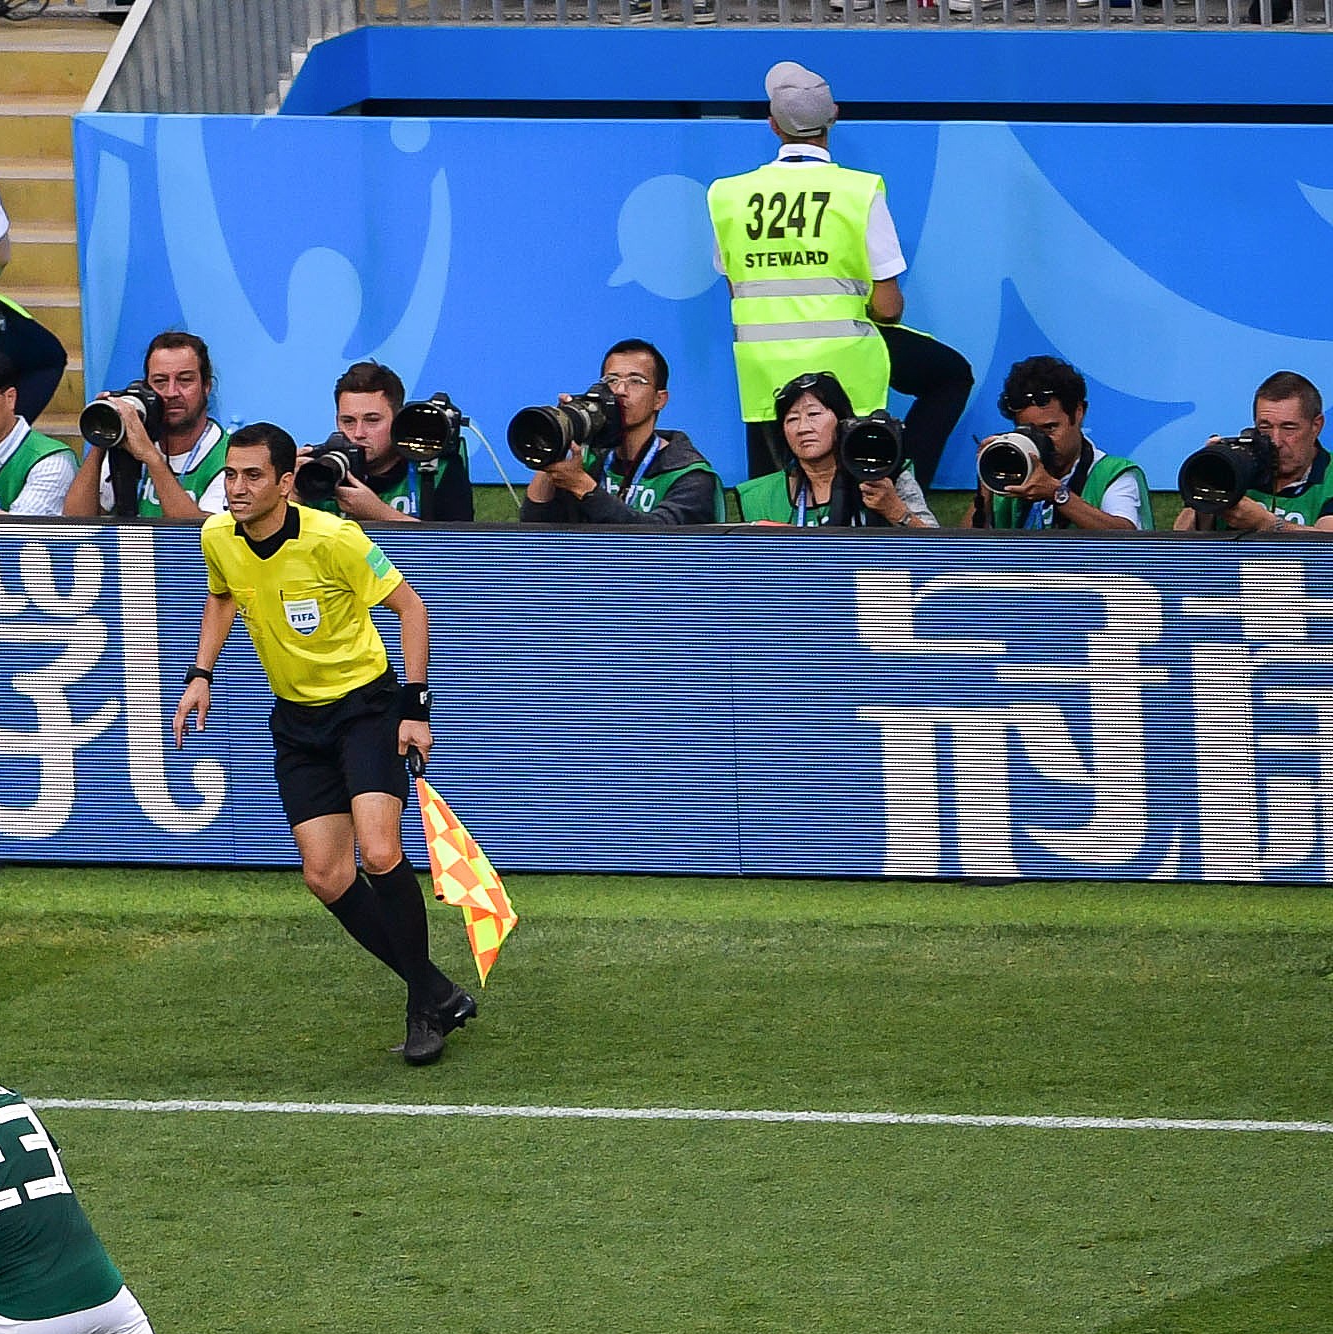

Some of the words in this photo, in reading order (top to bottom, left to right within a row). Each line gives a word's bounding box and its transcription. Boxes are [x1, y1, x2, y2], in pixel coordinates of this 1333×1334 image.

[745, 191, 831, 240] 3247
[744, 251, 829, 268] STEWARD
[290, 612, 317, 623] FIFA
